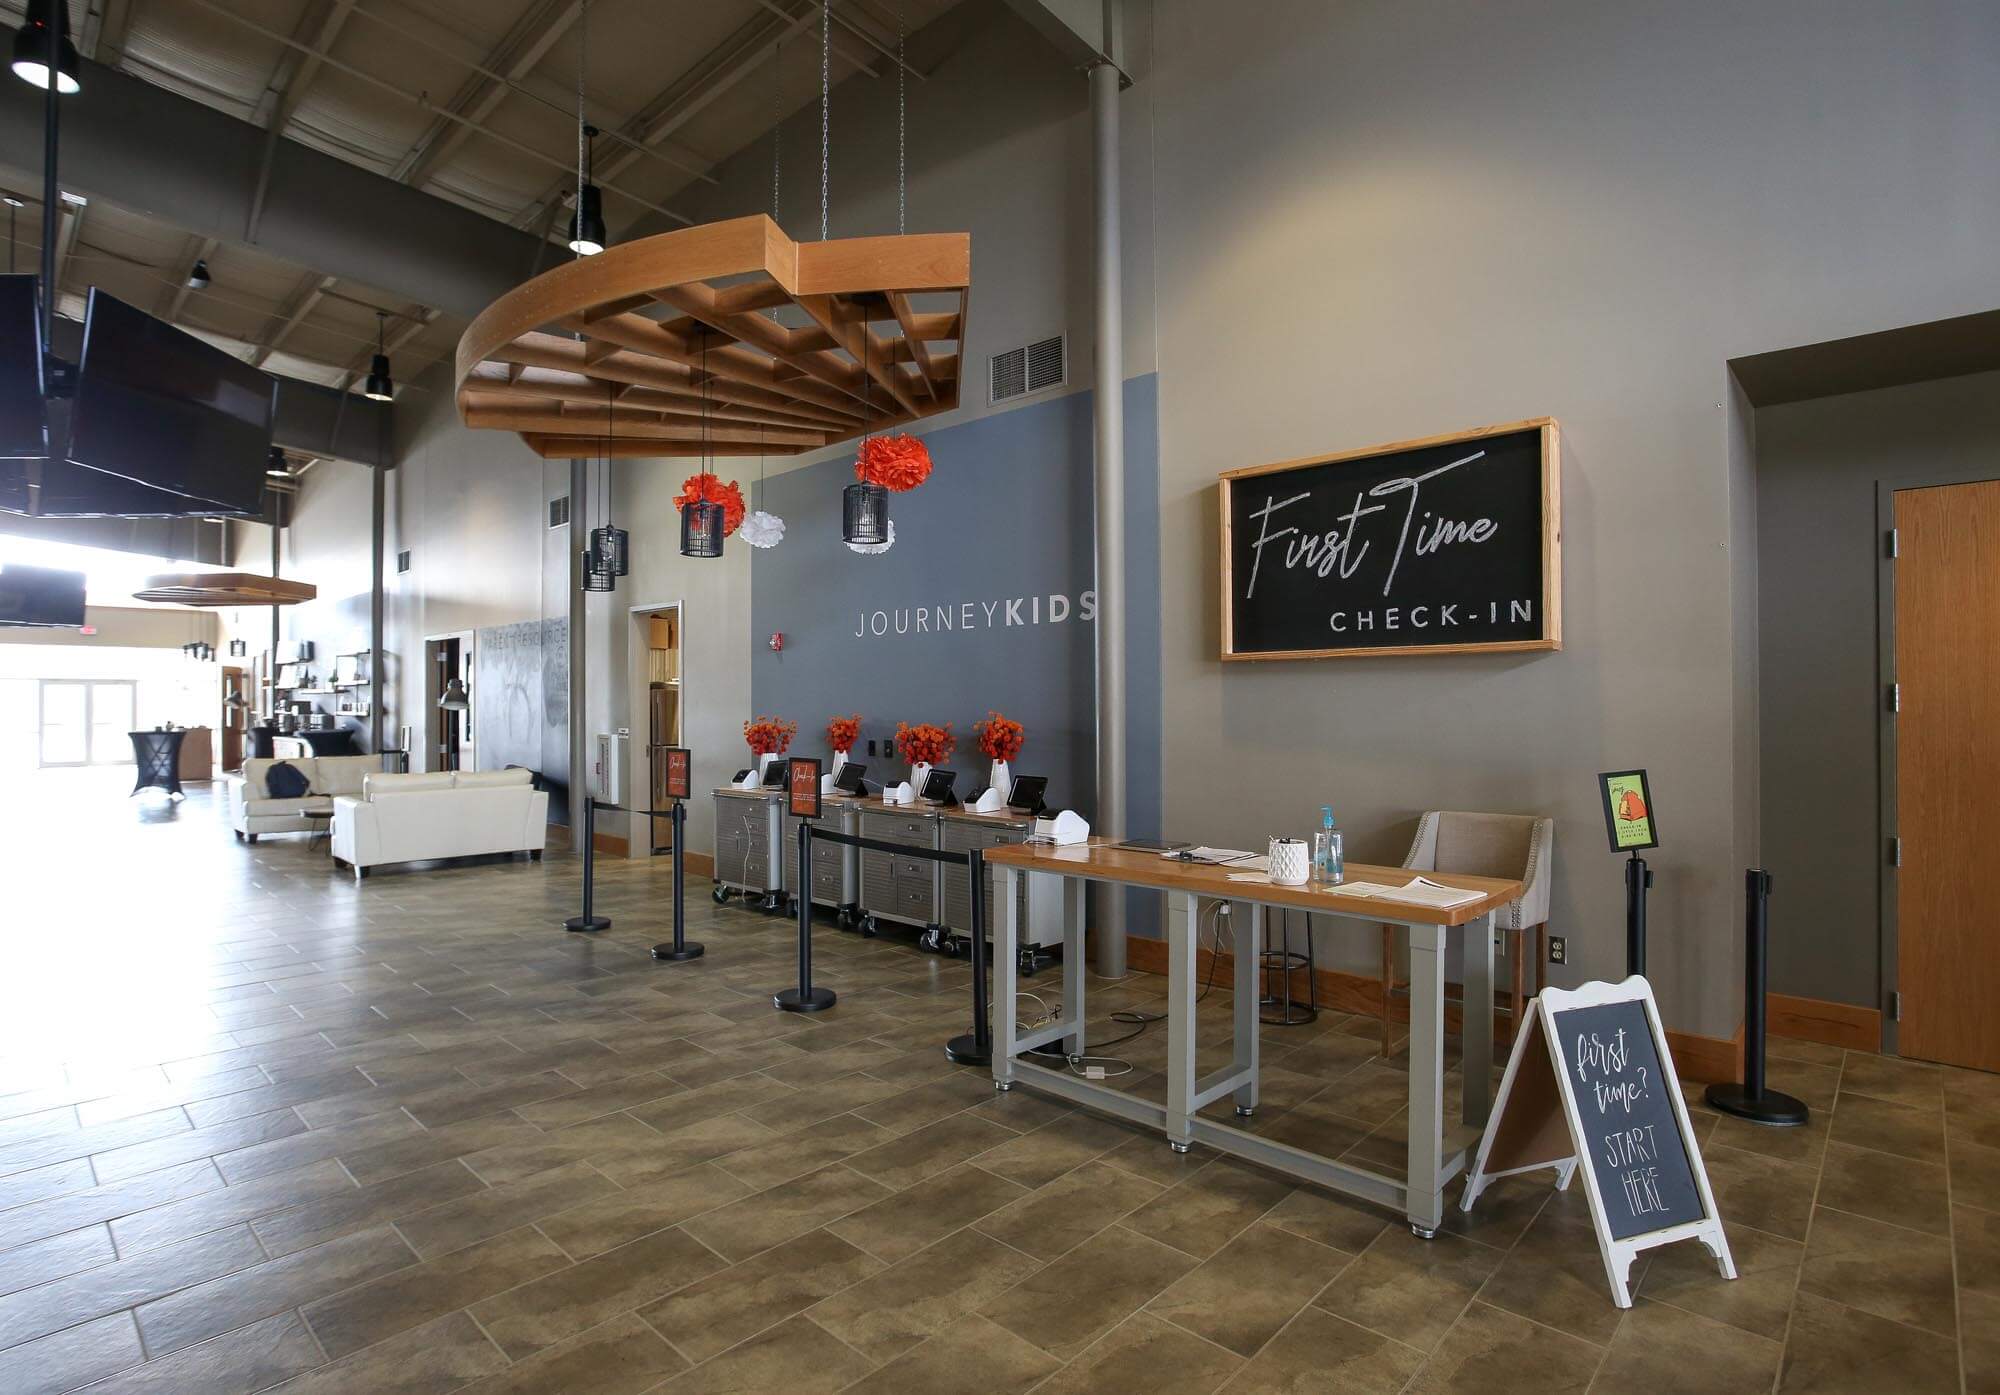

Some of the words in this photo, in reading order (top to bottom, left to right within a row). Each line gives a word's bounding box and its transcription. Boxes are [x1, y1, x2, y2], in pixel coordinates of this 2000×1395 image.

[1246, 491, 1387, 600] First
[1368, 450, 1498, 598] Time
[1329, 598, 1534, 634] CHECK-IN
[1576, 1027, 1630, 1083] first
[1592, 1066, 1650, 1115] time?
[1604, 1124, 1658, 1168] START
[1620, 1166, 1670, 1217] HERE
